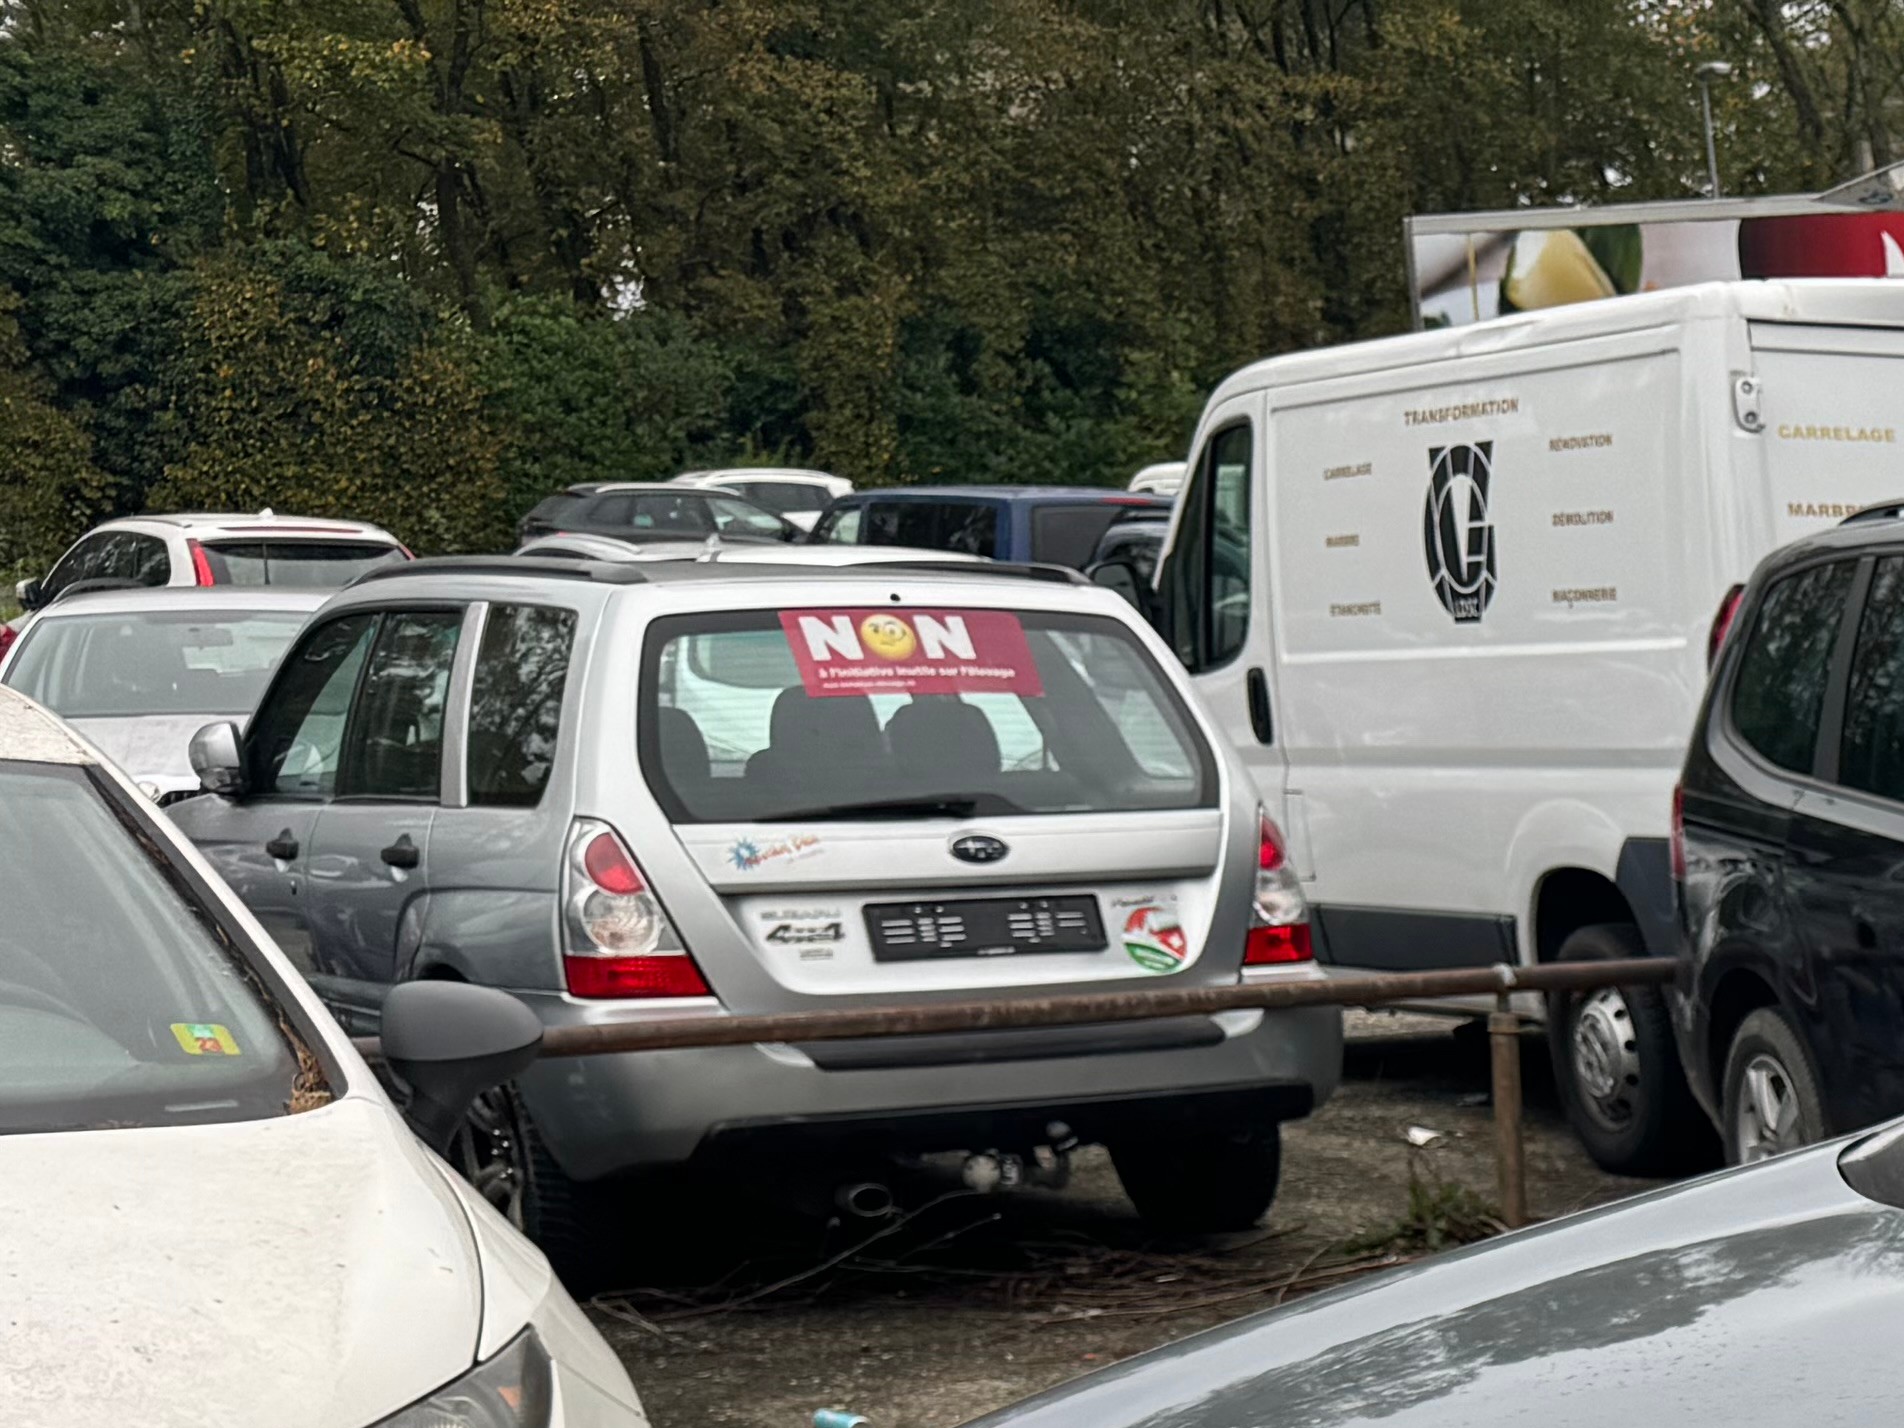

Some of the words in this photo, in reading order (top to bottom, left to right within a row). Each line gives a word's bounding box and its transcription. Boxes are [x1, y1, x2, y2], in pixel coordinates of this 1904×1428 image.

[1404, 398, 1519, 426] TRANSFORMATION
[1549, 433, 1613, 451] RÉNOVATION
[1778, 424, 1896, 443] CARRELAGE
[1552, 510, 1614, 527] DÉMOLITION
[1788, 503, 1864, 518] MARBR
[1552, 587, 1617, 608] MAÇONNERIE
